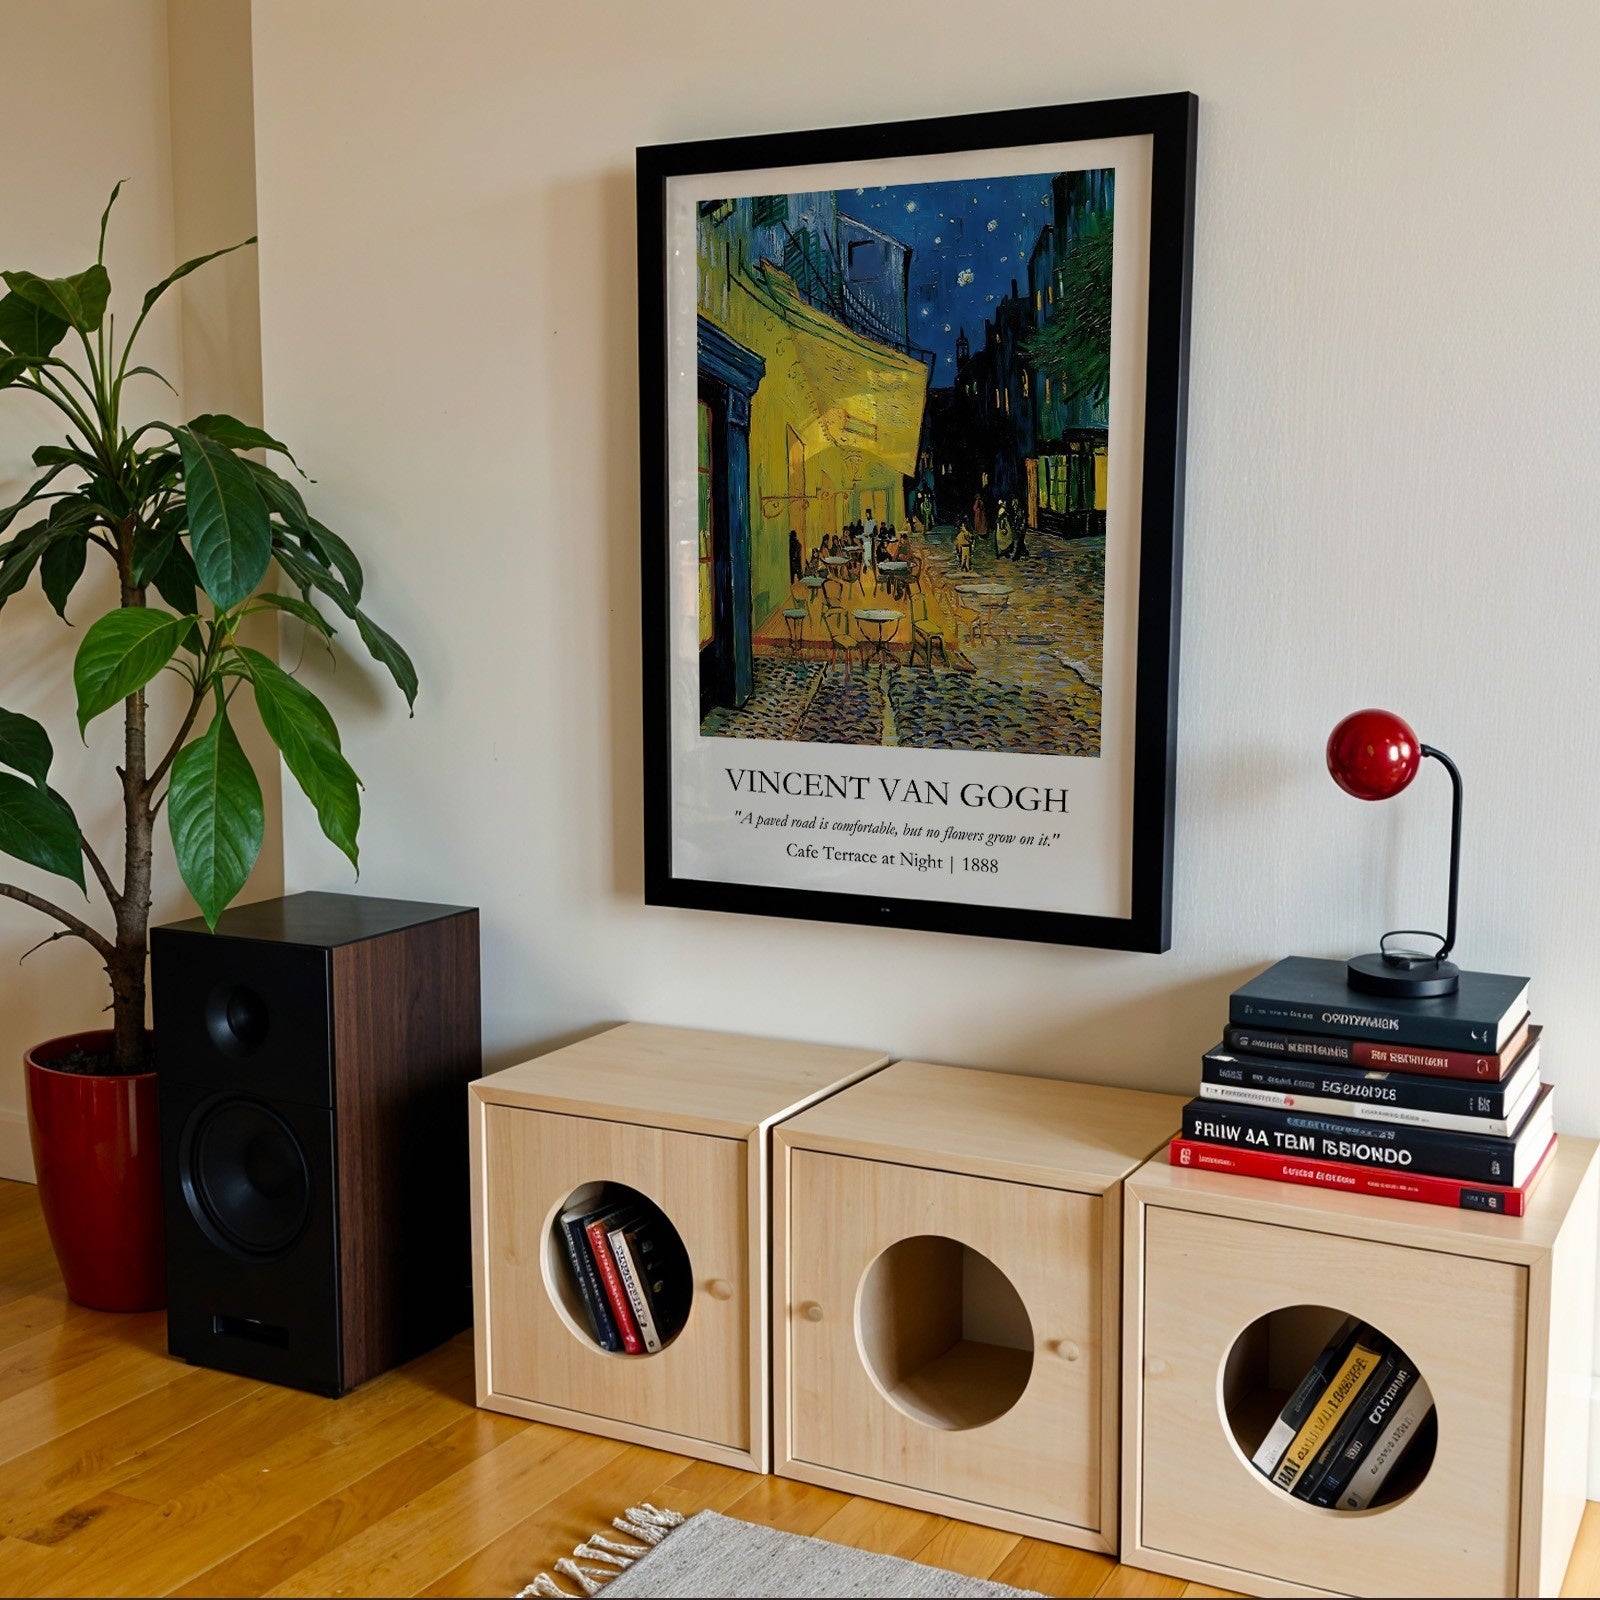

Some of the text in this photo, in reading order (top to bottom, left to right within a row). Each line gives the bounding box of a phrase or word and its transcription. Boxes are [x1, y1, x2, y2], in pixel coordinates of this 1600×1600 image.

[724, 767, 1070, 813] VINCENT VAN GOGH
[734, 810, 1061, 847] "A paved road is comfortable, but no flowers grow on it."
[785, 842, 820, 859] Cafe
[822, 845, 878, 864] Terrace
[881, 853, 897, 865] at
[899, 851, 944, 873] Night
[962, 857, 999, 874] 1888
